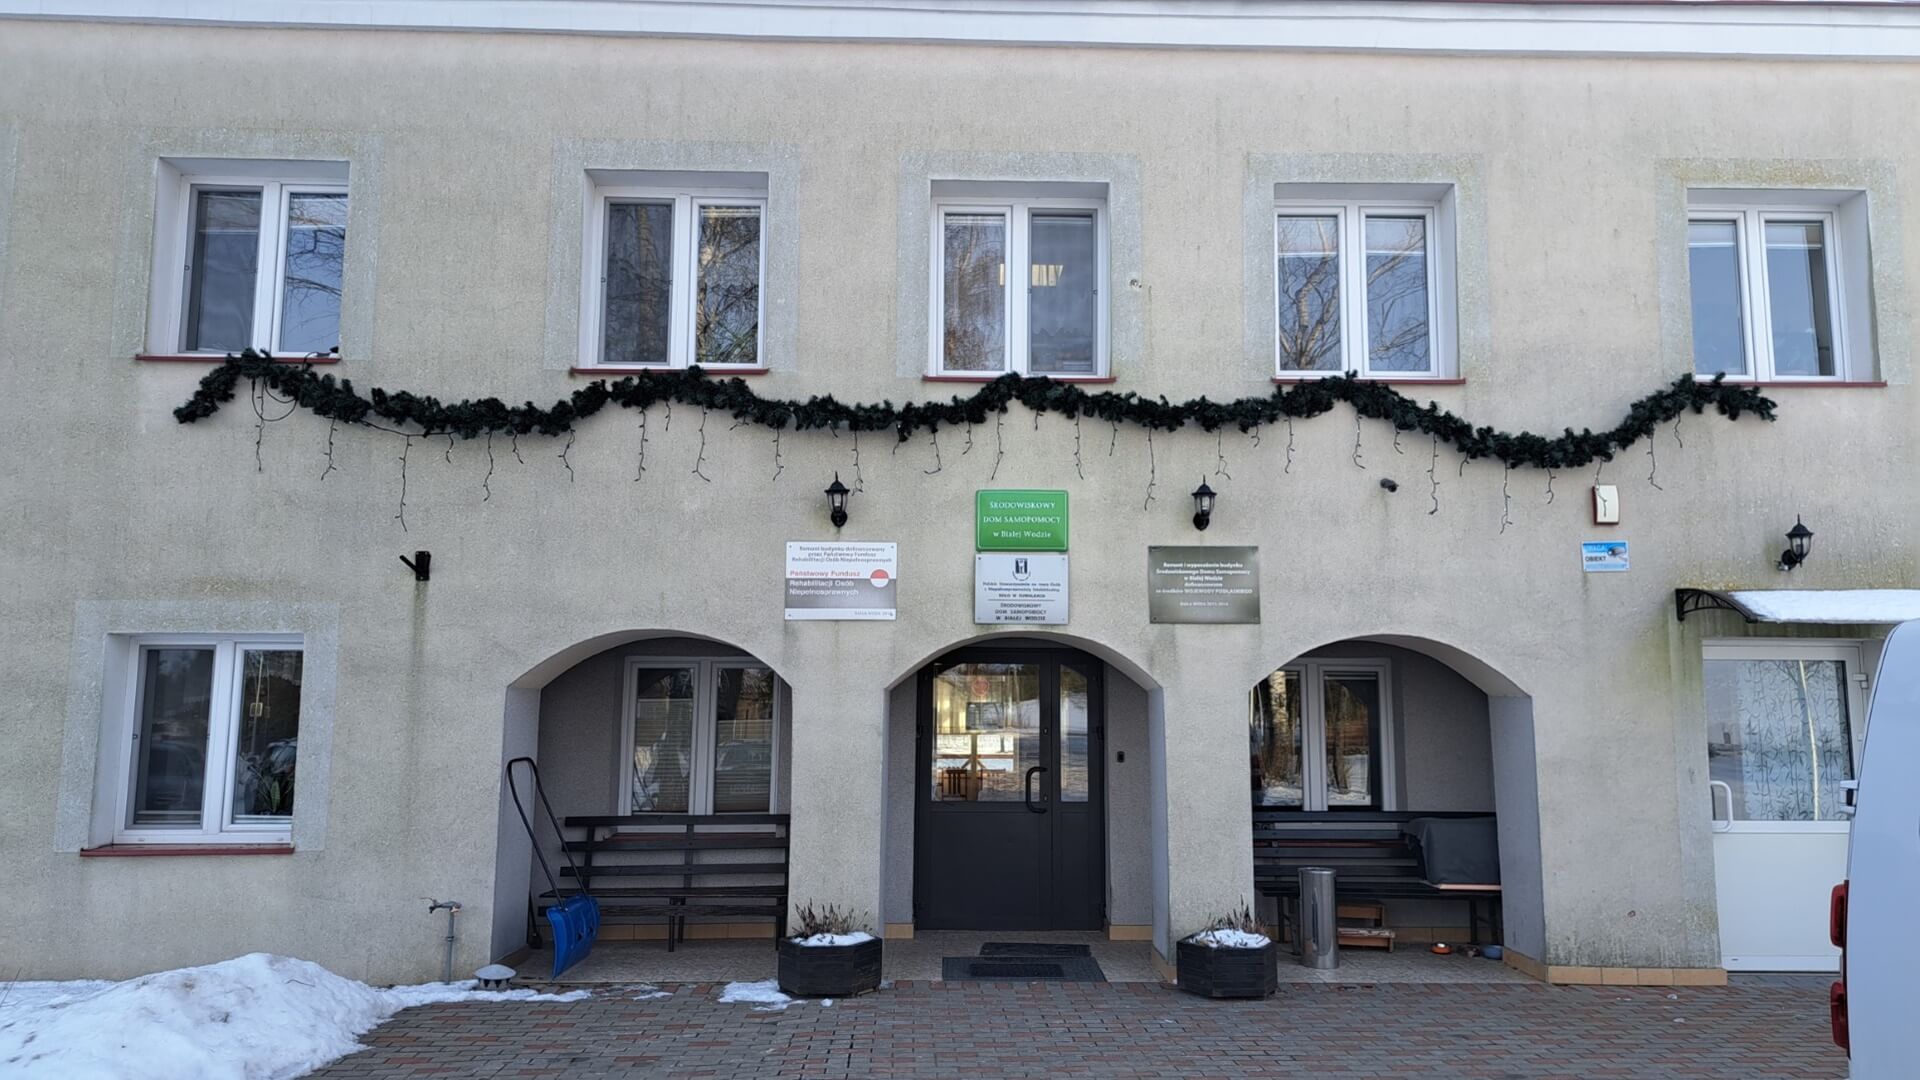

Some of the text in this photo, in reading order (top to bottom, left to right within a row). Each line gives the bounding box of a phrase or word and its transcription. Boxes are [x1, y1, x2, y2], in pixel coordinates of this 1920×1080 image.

[990, 501, 1056, 509] ŚRODOWISKOWY
[1001, 530, 1022, 539] Białej
[1024, 530, 1052, 538] Wodzie
[789, 579, 855, 588] Rehabilitacji Osób
[789, 588, 860, 597] Niepełnosprawnych
